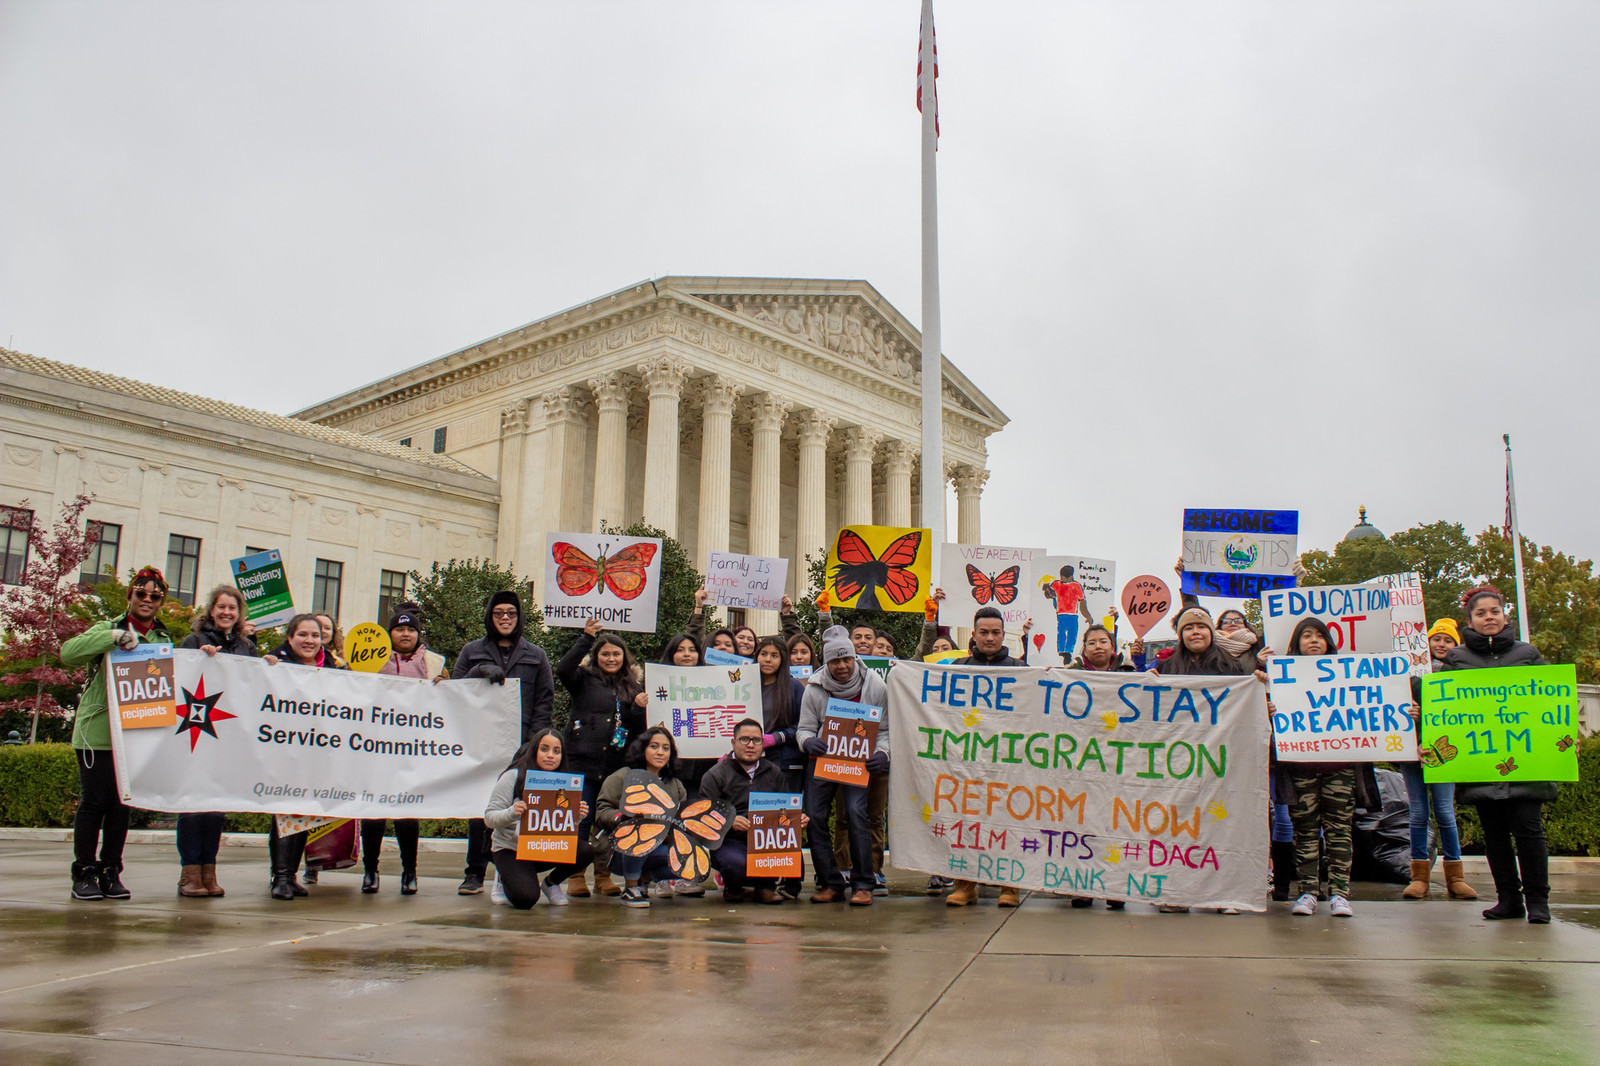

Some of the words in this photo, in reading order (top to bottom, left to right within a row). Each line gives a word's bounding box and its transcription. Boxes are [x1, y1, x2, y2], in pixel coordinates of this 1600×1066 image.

[1187, 511, 1276, 532] #HOME
[960, 547, 985, 559] WE
[986, 549, 1010, 561] ARE
[1182, 538, 1218, 567] SAVE
[1258, 539, 1290, 568] TPS
[710, 552, 750, 577] Family
[755, 559, 771, 574] Is
[238, 568, 282, 589] Residency
[706, 573, 739, 588] Home
[748, 578, 769, 591] and
[1136, 581, 1162, 592] HOME
[1190, 571, 1221, 596] IS
[1229, 573, 1287, 597] HERE
[242, 584, 266, 601] Now!
[1268, 588, 1390, 617] EDUCATION
[1389, 588, 1423, 606] ENTED
[1002, 609, 1028, 622] NERS
[1128, 594, 1167, 616] here
[356, 628, 381, 639] HOME
[1326, 615, 1367, 651] OT
[1391, 621, 1413, 638] DAD
[350, 642, 387, 663] here
[1392, 636, 1408, 652] CE
[1407, 633, 1429, 651] WAS
[116, 666, 130, 676] for
[1272, 658, 1297, 684] I
[1316, 656, 1409, 682] STAND
[118, 676, 172, 702] DACA
[921, 670, 1018, 712] HERE
[1038, 679, 1093, 720] TO
[1118, 683, 1230, 725] STAY
[1305, 685, 1383, 709] WITH
[1428, 678, 1571, 703] Immigration
[122, 706, 168, 719] recipients
[260, 693, 363, 721] American
[371, 706, 445, 729] Friends
[829, 704, 866, 715] #ResidencyNow
[1273, 702, 1415, 734] DREAMERS
[1424, 708, 1484, 726] reform
[1494, 705, 1529, 724] for
[1541, 704, 1571, 726] all
[672, 705, 746, 738] HERE
[828, 719, 840, 731] for
[257, 724, 341, 749] Service
[348, 732, 464, 757] Committee
[826, 734, 870, 759] DACA
[917, 726, 1227, 780] IMMIGRATION
[823, 763, 862, 776] recipients
[528, 777, 567, 786] #ResidencyNow
[252, 782, 308, 799] Quaker
[313, 785, 356, 801] values
[361, 789, 374, 803] in
[378, 791, 424, 804] action
[528, 793, 541, 804] for
[752, 798, 787, 806] #ResidencyNow
[933, 773, 1087, 825] REFORM
[1112, 797, 1202, 840] NOW
[527, 809, 575, 831] DACA
[752, 814, 764, 824] for
[527, 839, 569, 852] recipients
[754, 827, 798, 850] DACA
[931, 820, 1008, 851] #11M
[1020, 829, 1097, 860] #TPS
[1123, 839, 1220, 871] #DACA
[755, 856, 794, 869] recipients
[1043, 862, 1106, 891] BANK
[1126, 872, 1168, 899] NJ
